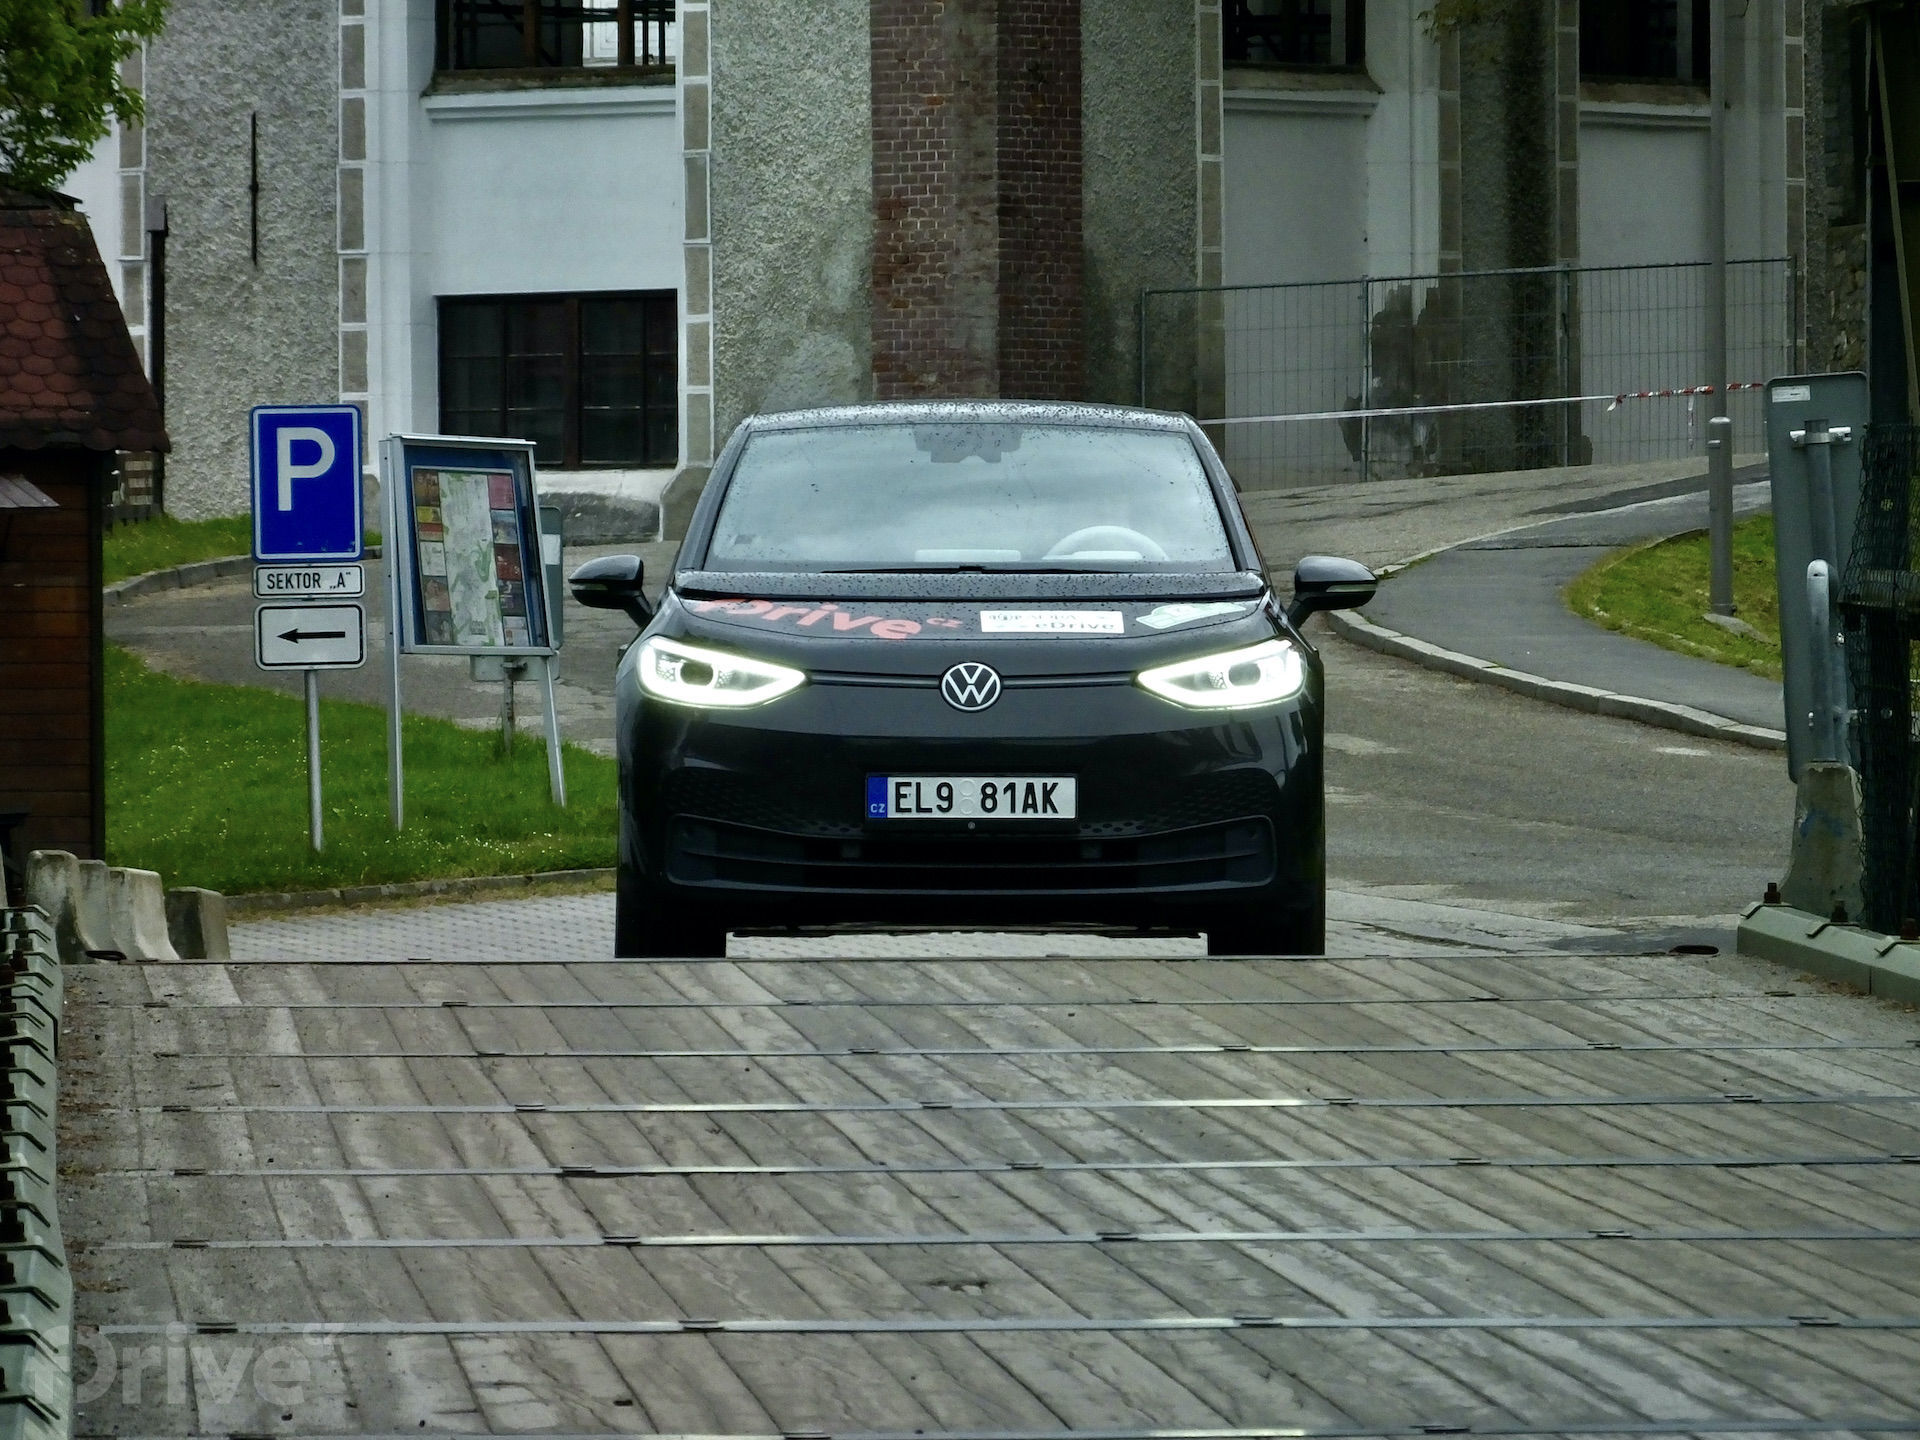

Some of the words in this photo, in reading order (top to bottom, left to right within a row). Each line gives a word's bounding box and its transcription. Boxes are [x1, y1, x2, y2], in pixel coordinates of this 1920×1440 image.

[276, 427, 335, 512] P
[266, 572, 321, 590] SEKTOR
[870, 803, 886, 813] CZ
[895, 781, 954, 813] EL9
[980, 781, 1059, 814] 81AK
